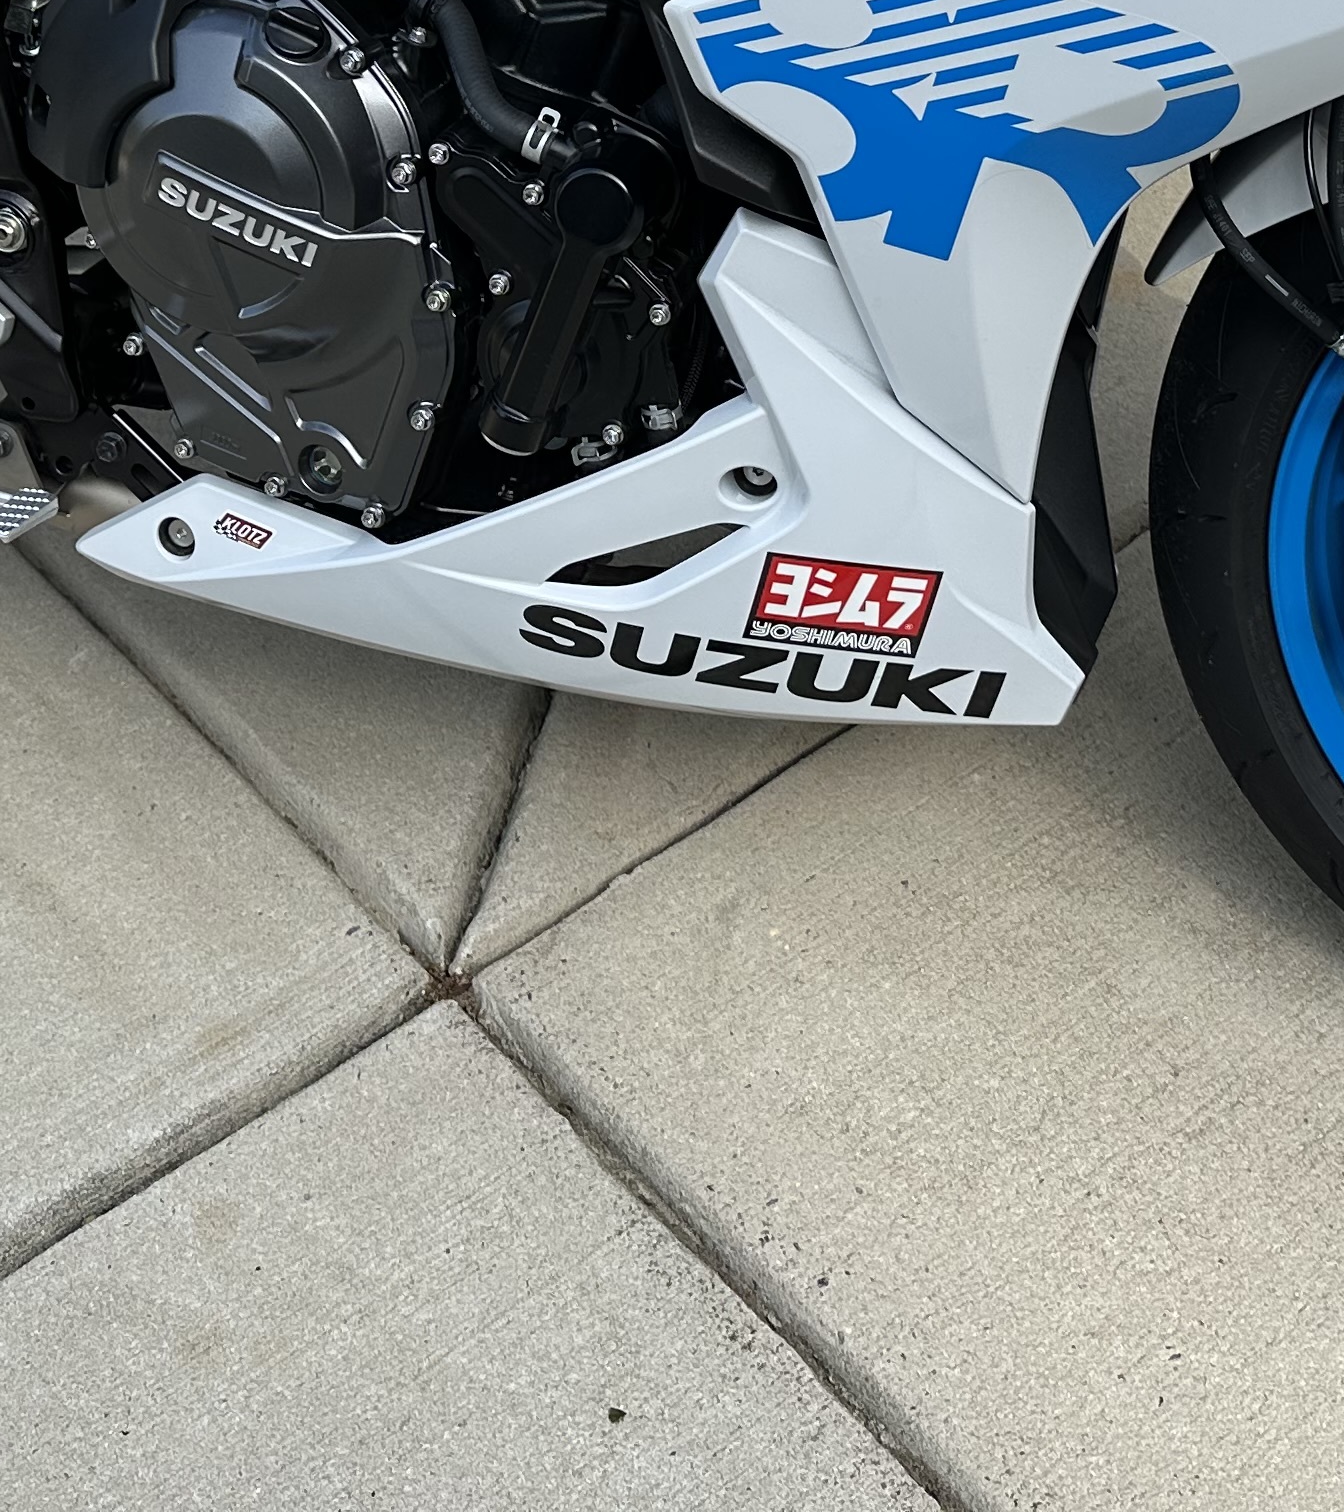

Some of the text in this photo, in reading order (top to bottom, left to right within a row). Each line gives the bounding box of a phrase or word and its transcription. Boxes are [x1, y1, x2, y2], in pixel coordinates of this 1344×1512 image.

[157, 177, 319, 268] SUZUKI
[221, 516, 268, 545] KLOTZ
[764, 562, 929, 631] ヨシムラ
[518, 603, 1008, 719] SUZUKI
[749, 620, 914, 655] YOSHIMURA
